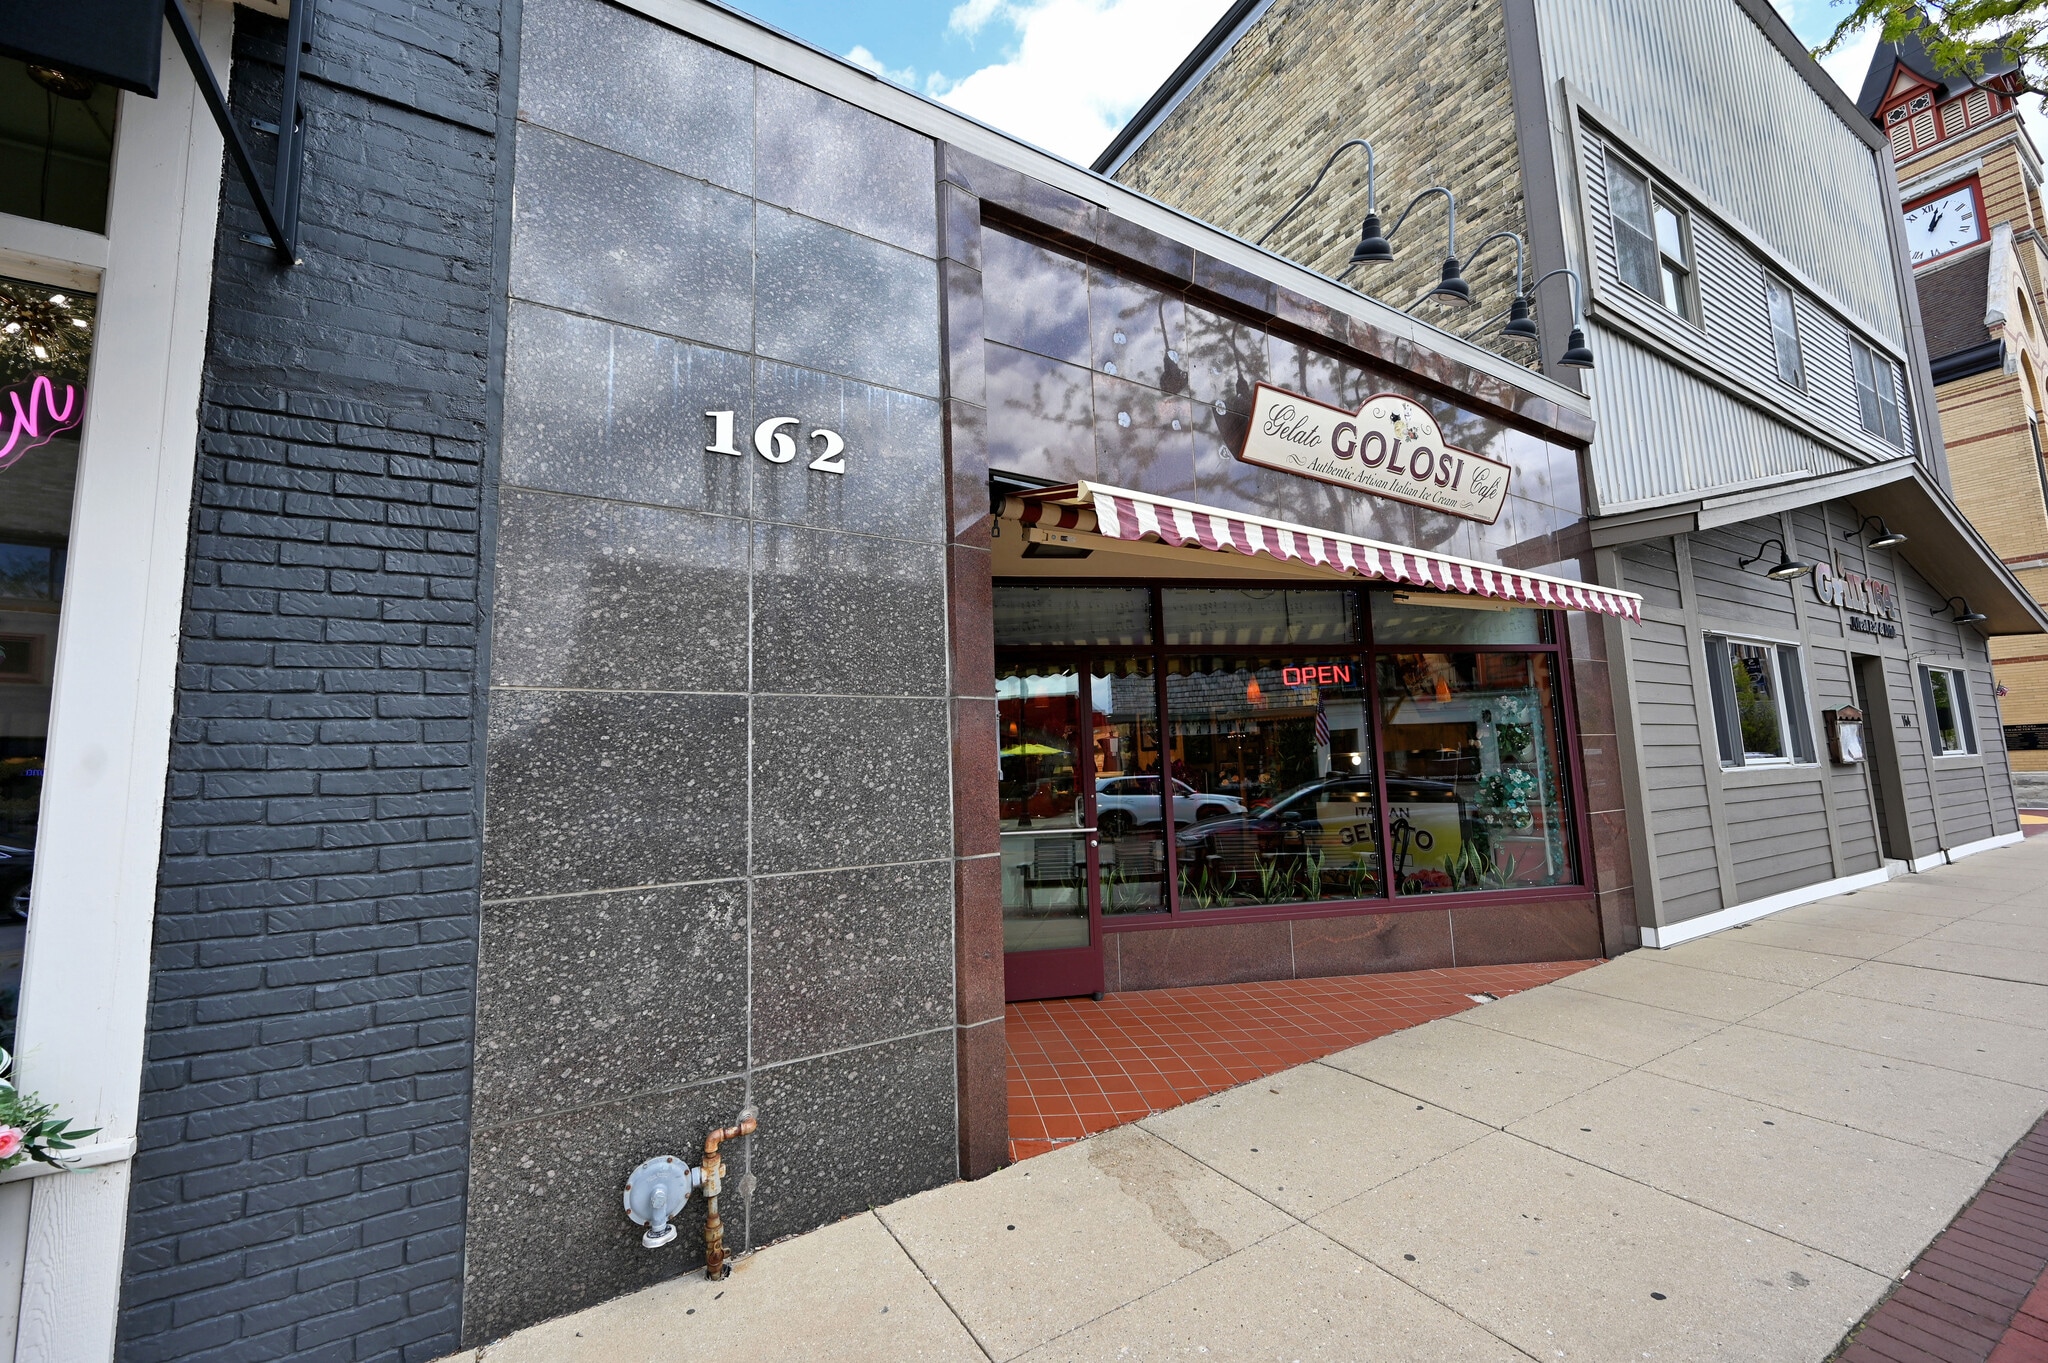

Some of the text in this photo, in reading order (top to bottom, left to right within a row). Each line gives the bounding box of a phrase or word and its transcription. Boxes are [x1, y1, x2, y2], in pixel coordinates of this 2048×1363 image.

[704, 409, 846, 475] 162
[1263, 403, 1323, 448] Gelato
[1331, 421, 1466, 492] GOLOSI
[1307, 457, 1459, 508] Authentic Artisan Italian Ice Cream
[1282, 665, 1351, 686] OPEN
[1355, 806, 1411, 818] ITAAN
